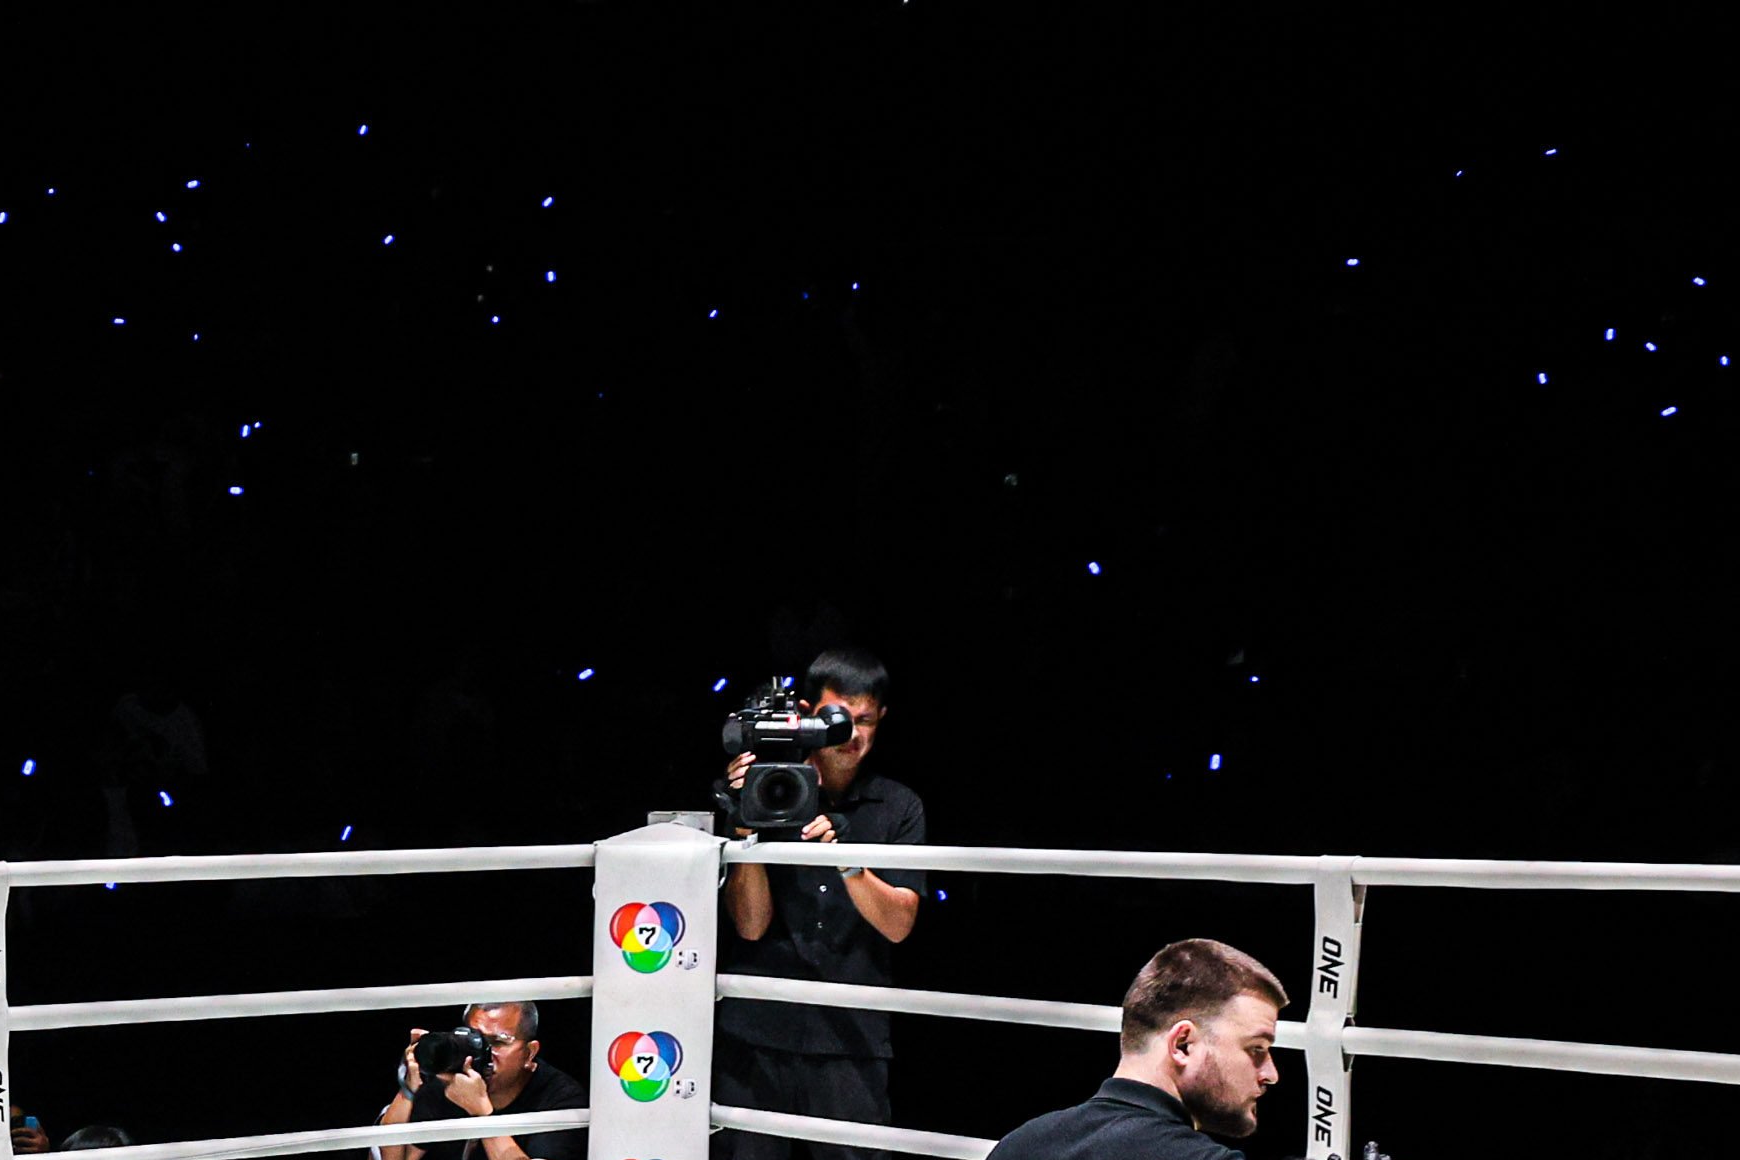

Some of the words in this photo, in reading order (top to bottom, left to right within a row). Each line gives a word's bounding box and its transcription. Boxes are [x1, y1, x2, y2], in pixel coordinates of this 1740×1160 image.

[638, 926, 657, 945] 7
[1315, 935, 1346, 1000] ONE
[636, 1055, 655, 1074] 7
[1311, 1085, 1338, 1148] ONE
